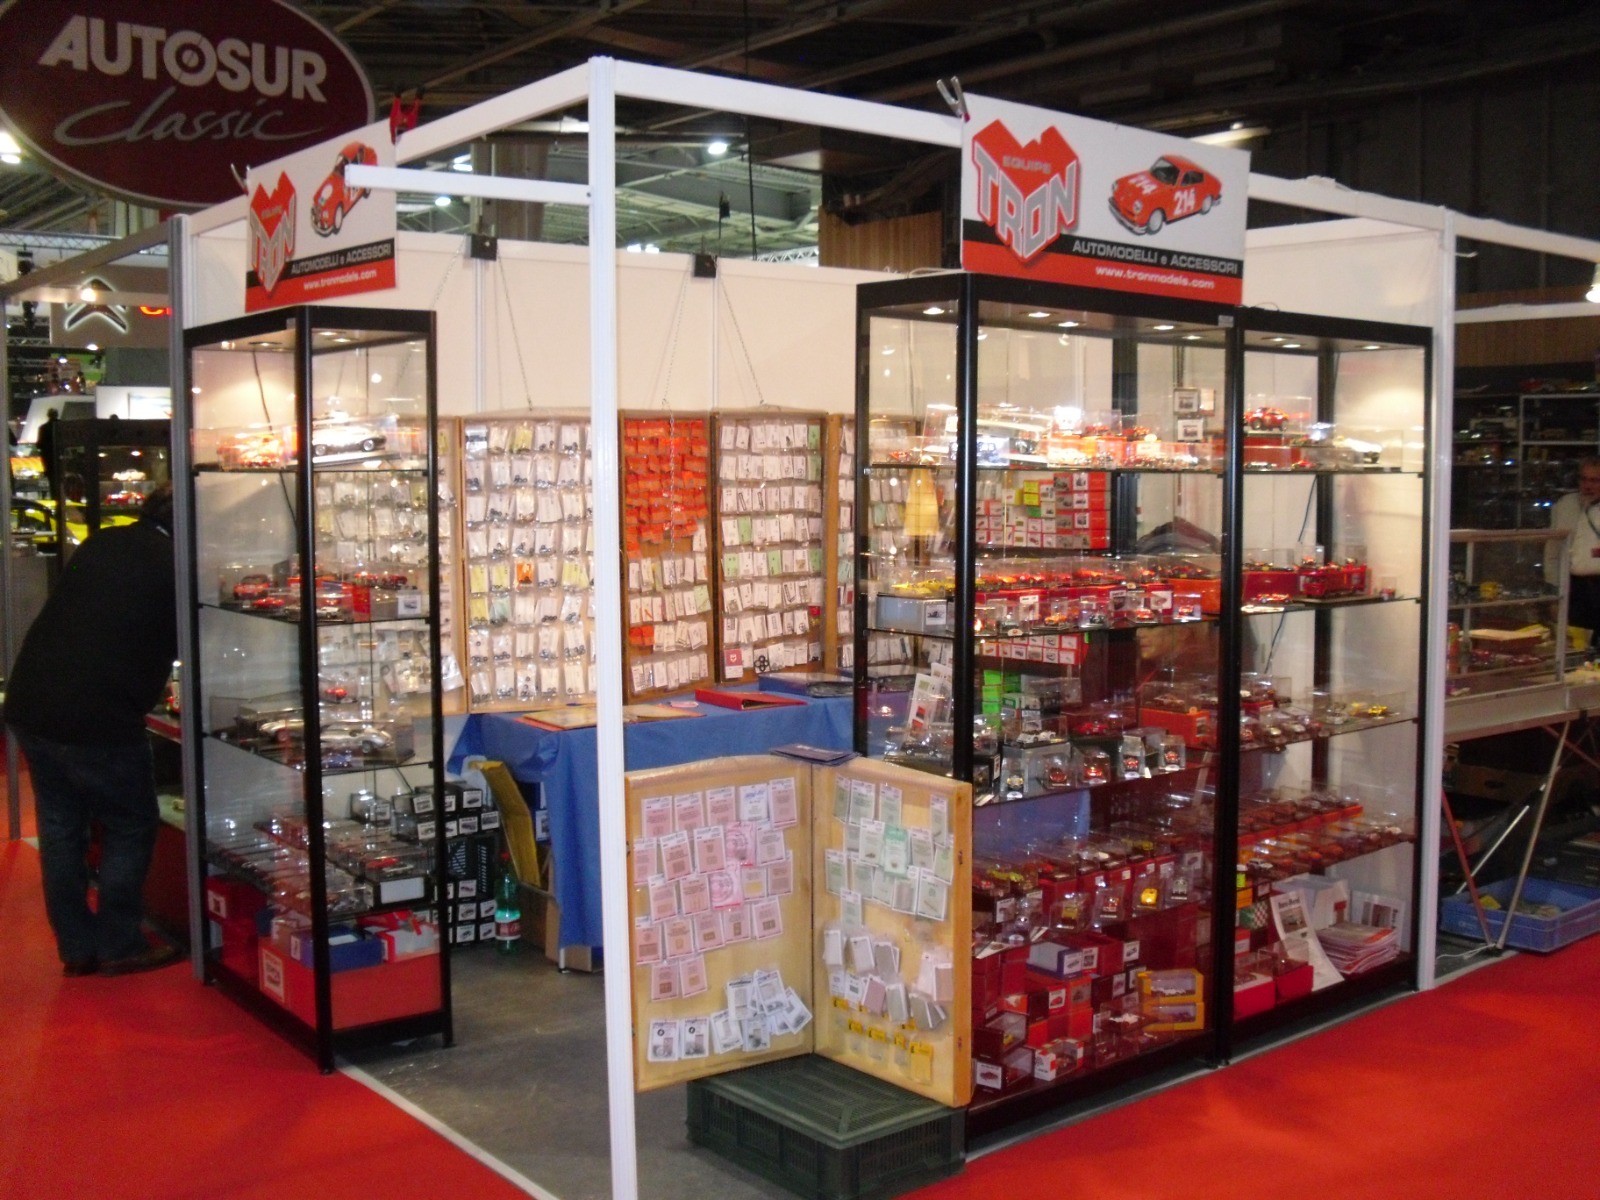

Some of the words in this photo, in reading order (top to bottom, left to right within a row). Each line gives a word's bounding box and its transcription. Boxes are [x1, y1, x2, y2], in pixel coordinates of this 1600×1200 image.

[38, 14, 328, 103] AUTOSUR
[53, 86, 325, 146] Classic
[975, 142, 1077, 260] TRON
[1173, 187, 1196, 215] 214
[291, 255, 339, 274] AUTOMODELLI
[346, 243, 392, 264] ACCESSORI
[1072, 241, 1158, 263] AUTOMODELLI
[1160, 256, 1168, 265] e
[1170, 255, 1238, 275] ACCESSORI
[1095, 266, 1215, 290] www.tronmodels.com
